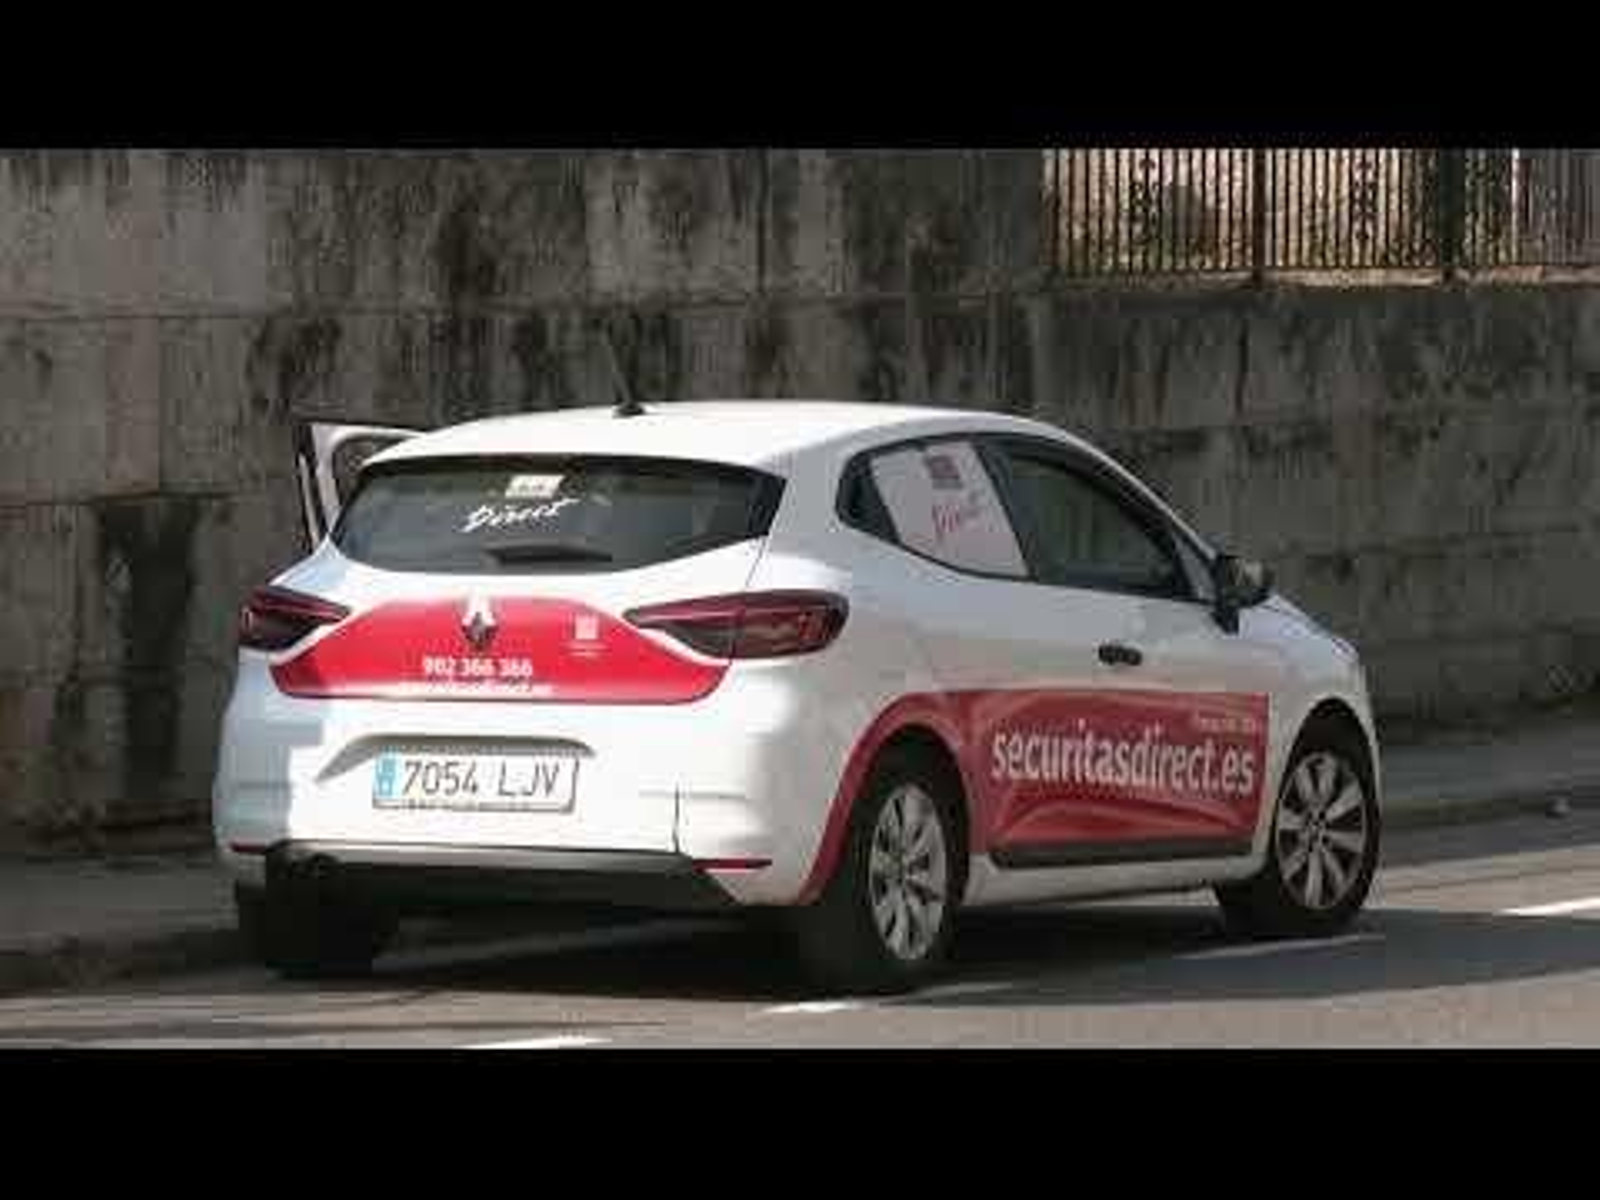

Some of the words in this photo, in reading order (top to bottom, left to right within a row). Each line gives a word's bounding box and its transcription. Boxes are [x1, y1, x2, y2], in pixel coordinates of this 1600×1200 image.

[403, 760, 479, 796] 7054
[497, 760, 560, 798] LJV
[991, 718, 1255, 795] securitasdirect.es
